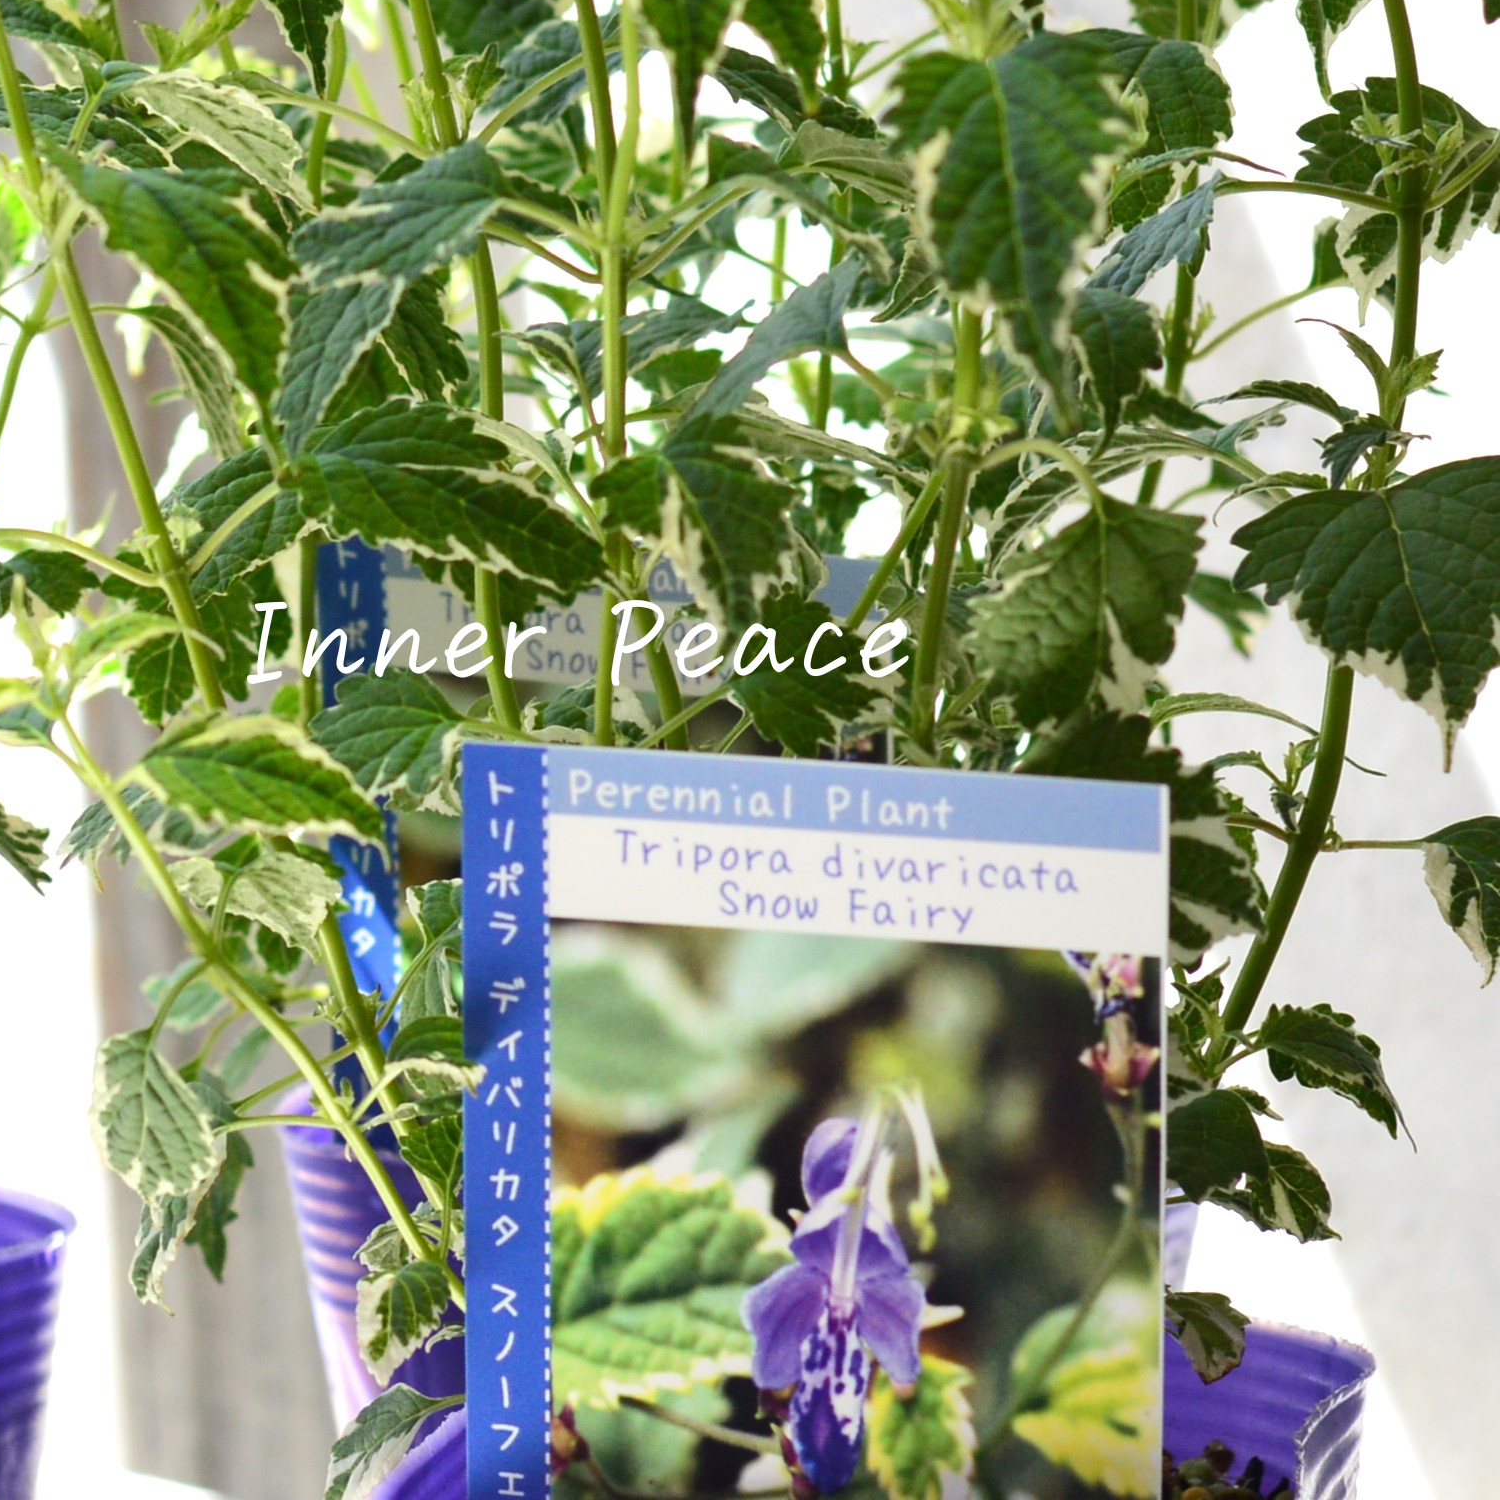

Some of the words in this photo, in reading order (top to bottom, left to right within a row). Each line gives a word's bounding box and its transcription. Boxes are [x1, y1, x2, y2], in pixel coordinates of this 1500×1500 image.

[568, 769, 794, 820] Perennial
[826, 778, 954, 832] Plant
[485, 770, 525, 946] トリポラ
[613, 828, 794, 874] Tripora
[821, 835, 1080, 894] divaricata
[718, 882, 819, 921] Snow
[849, 889, 974, 935] Fairy
